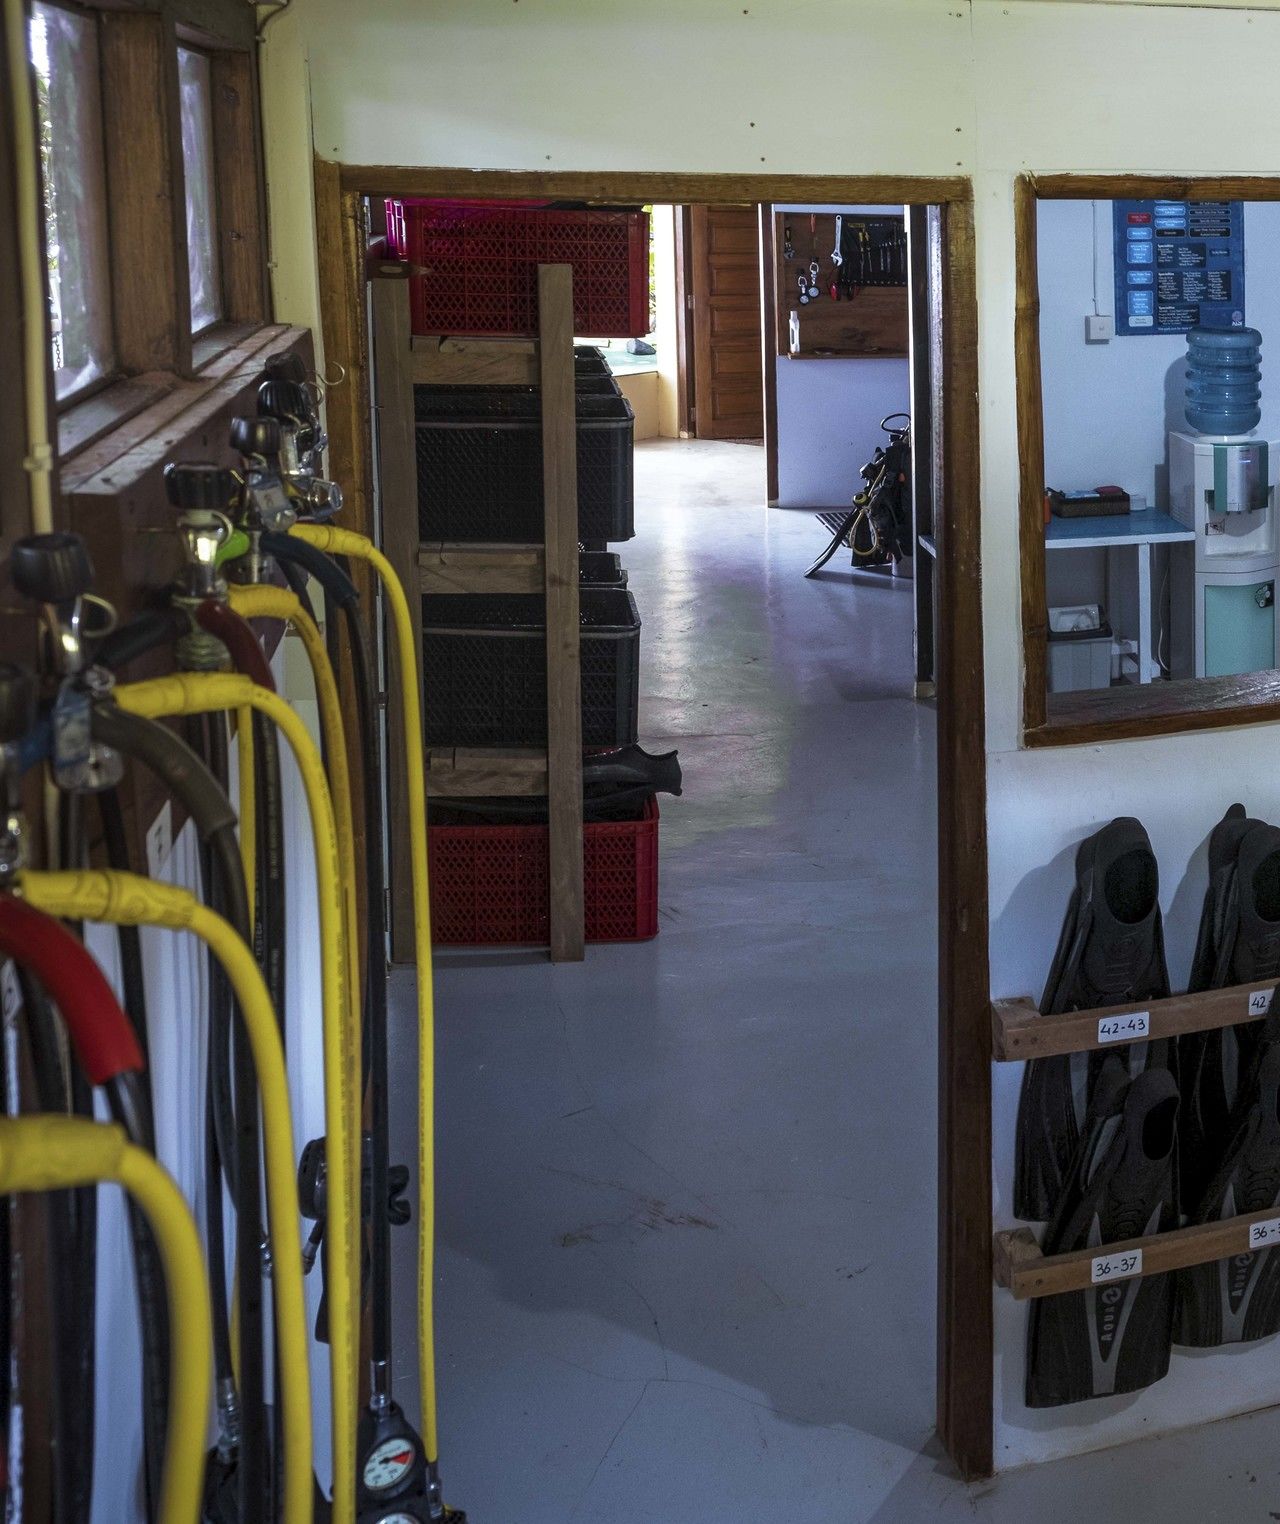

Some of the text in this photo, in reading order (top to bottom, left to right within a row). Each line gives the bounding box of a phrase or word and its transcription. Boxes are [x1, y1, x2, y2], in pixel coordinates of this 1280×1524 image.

[1251, 995, 1272, 1009] 42-
[1100, 1018, 1146, 1036] 42-43
[1095, 1256, 1137, 1277] 36-37
[1101, 1305, 1115, 1341] AQUA
